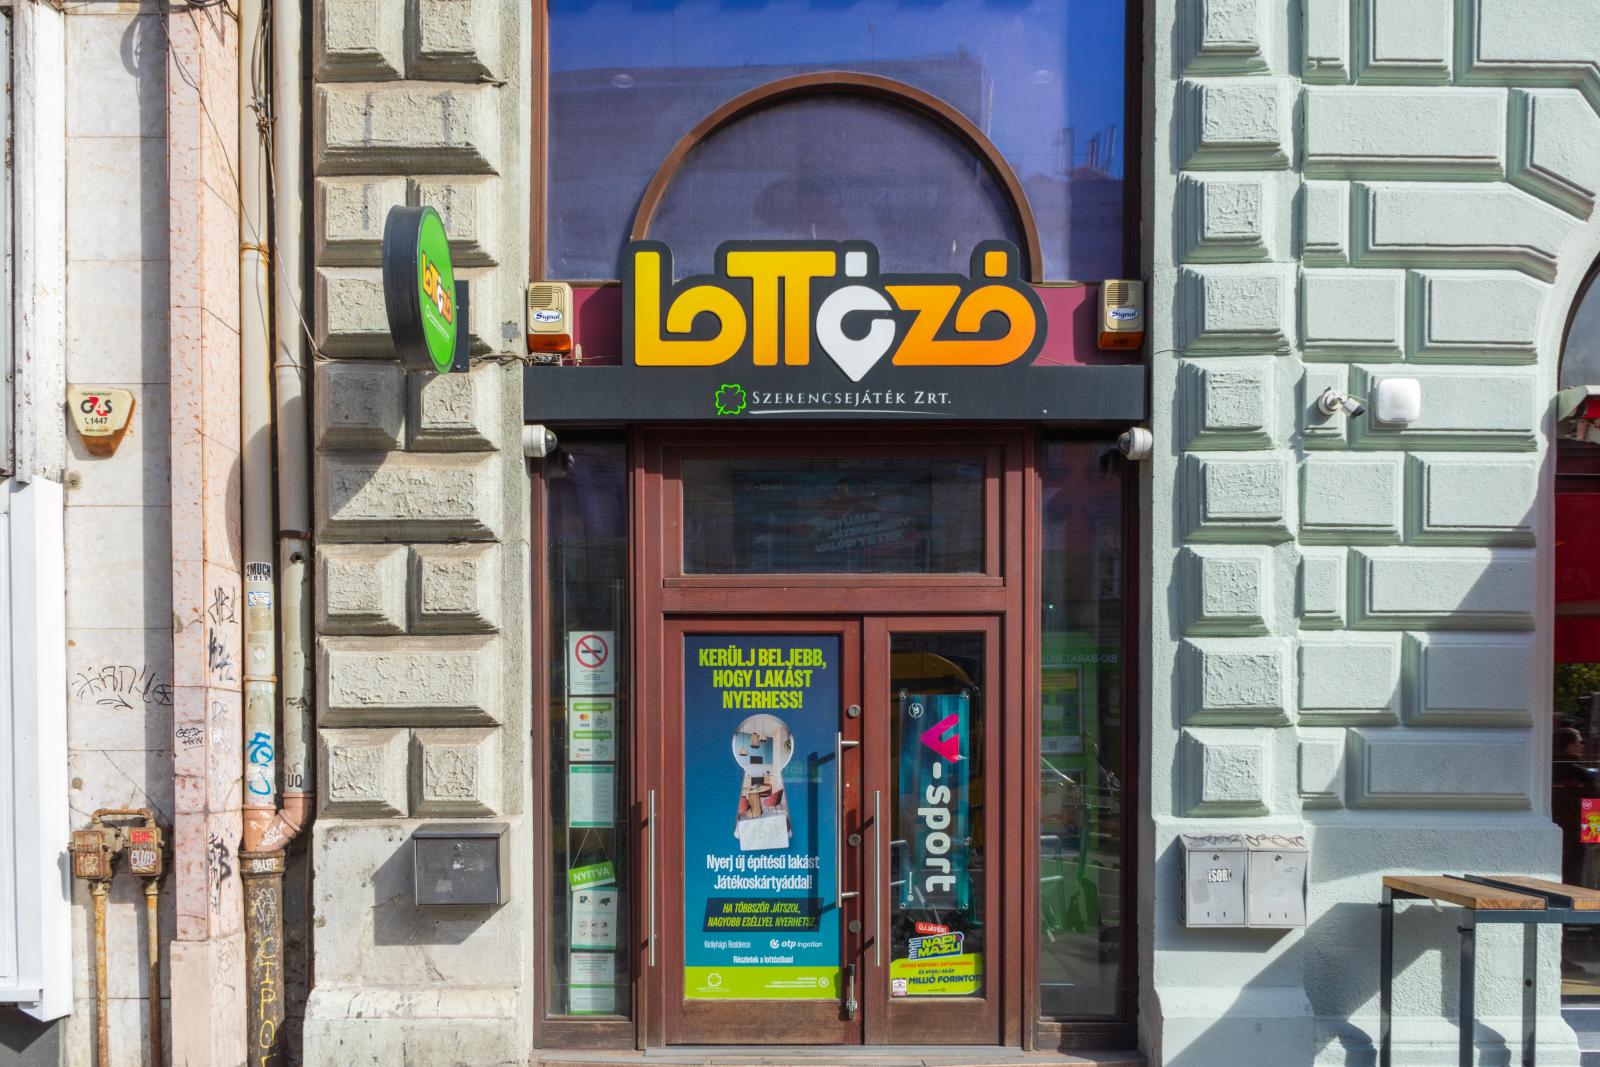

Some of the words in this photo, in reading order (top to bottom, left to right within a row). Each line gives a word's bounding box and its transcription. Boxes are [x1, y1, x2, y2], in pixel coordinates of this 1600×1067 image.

[535, 312, 561, 322] Signal
[1111, 309, 1137, 319] Signal
[81, 397, 112, 416] G4S
[699, 645, 755, 667] KERÜLJ
[758, 648, 827, 669] BELJEBB,
[713, 669, 752, 688] HOGY
[755, 666, 813, 688] LAKÁST
[722, 690, 803, 708] NYERHESS!
[706, 854, 734, 872] Nyerj
[735, 854, 745, 872] új
[747, 854, 786, 872] építésű
[788, 854, 820, 869] lakást
[573, 866, 611, 882] NYITVA
[713, 874, 812, 892] Játékoskártyáddal!
[723, 903, 733, 913] HA
[734, 902, 770, 913] TÖBBSZÖR
[707, 917, 741, 927] NAGYOBB
[742, 916, 773, 927] ESÉLLYEL
[781, 939, 796, 950] otp
[922, 934, 956, 948] NAPI
[909, 974, 935, 984] MILLIÓ
